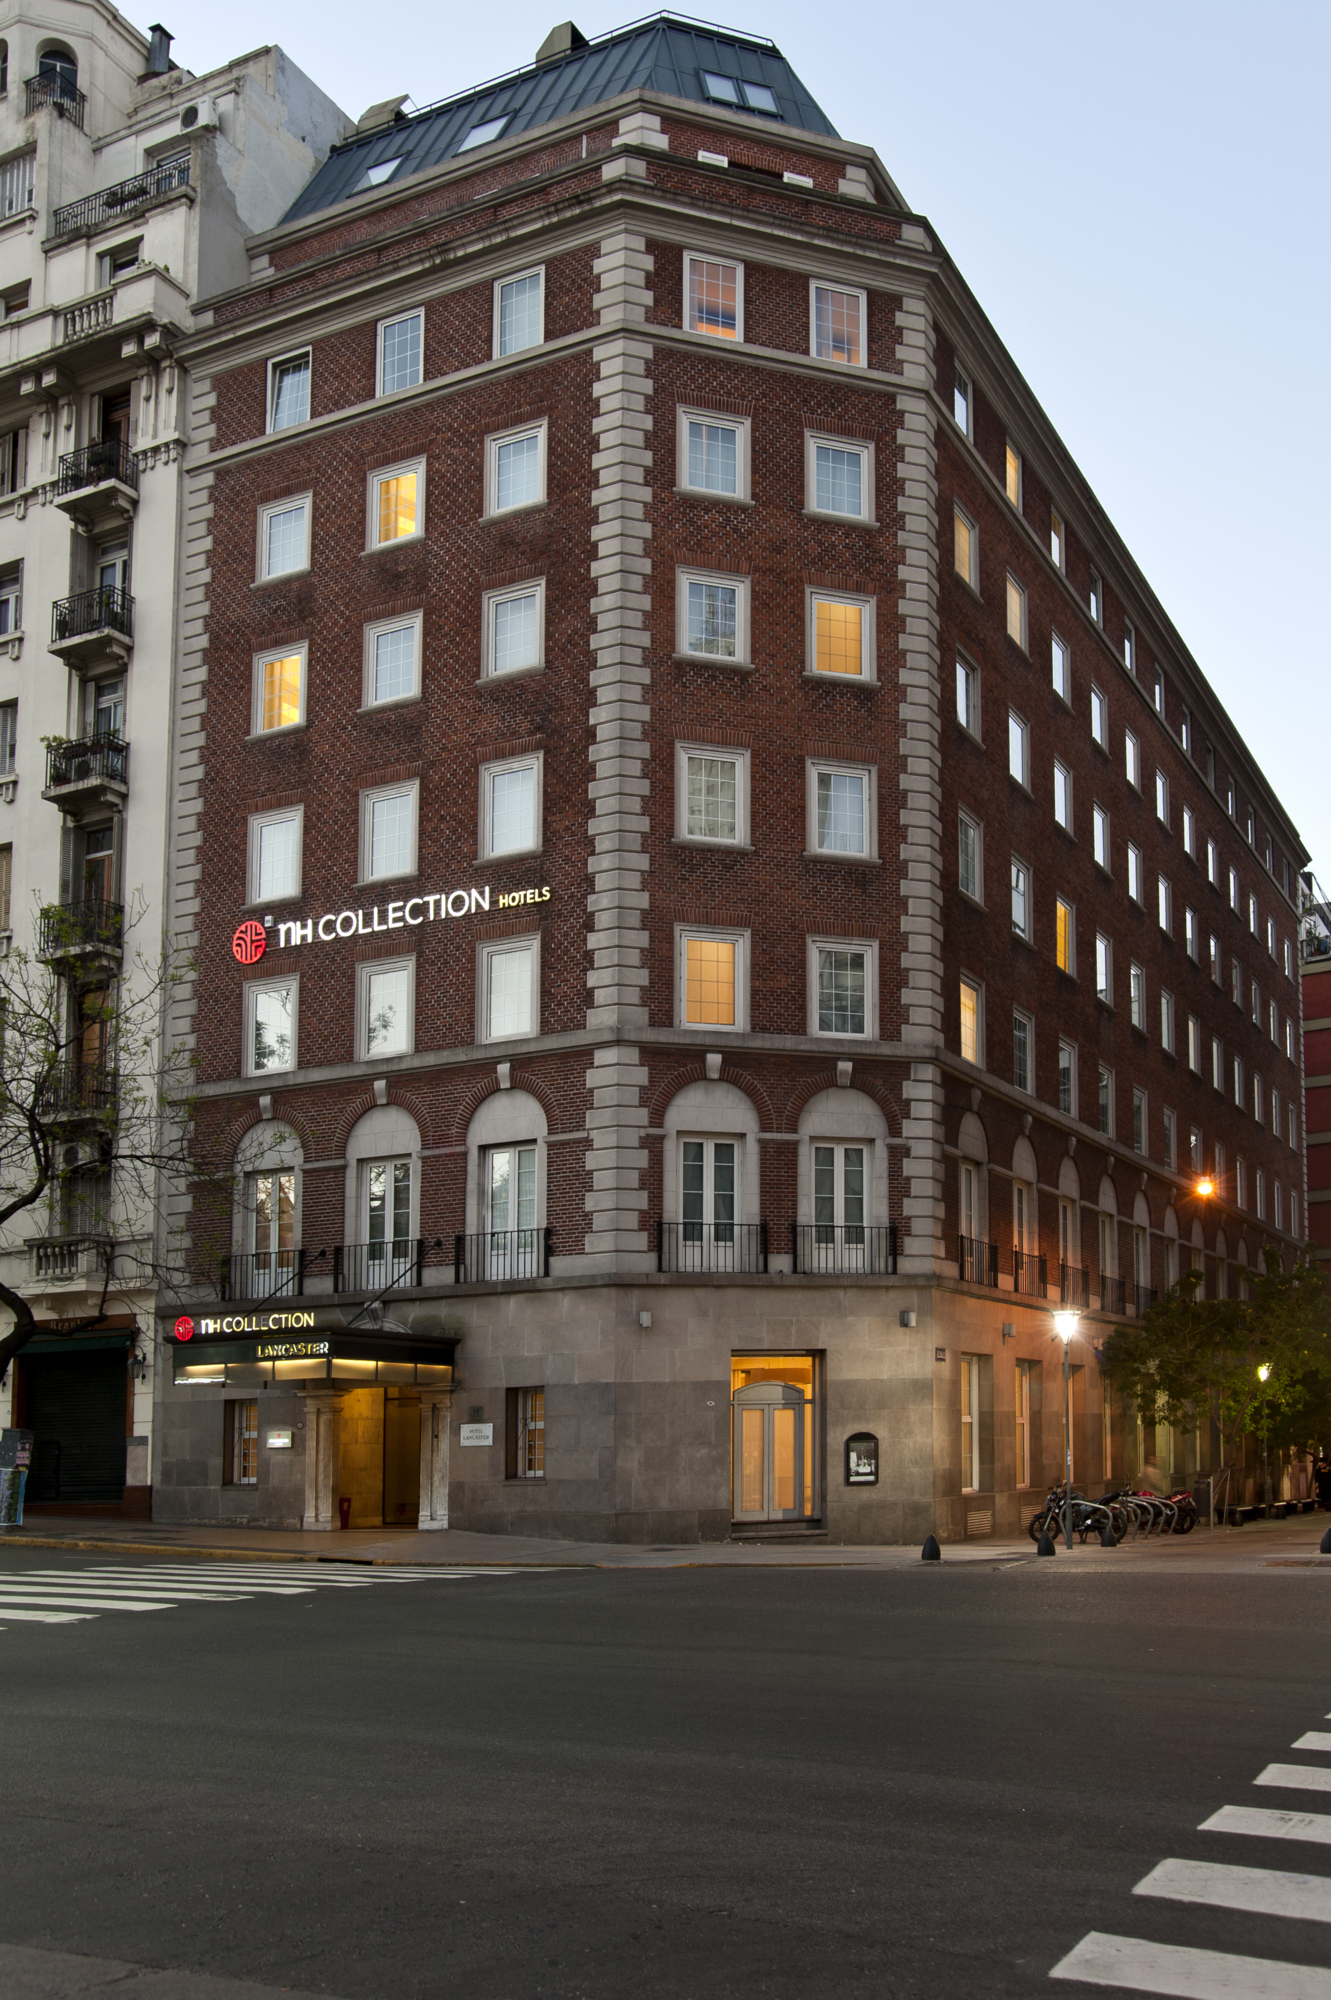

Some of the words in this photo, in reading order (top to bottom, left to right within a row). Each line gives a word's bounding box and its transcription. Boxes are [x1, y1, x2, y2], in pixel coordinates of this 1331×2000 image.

[319, 886, 490, 941] COLLECTION
[498, 886, 551, 908] HOTELS
[222, 1312, 315, 1333] COLLECTION
[256, 1341, 329, 1358] LANCASTER
